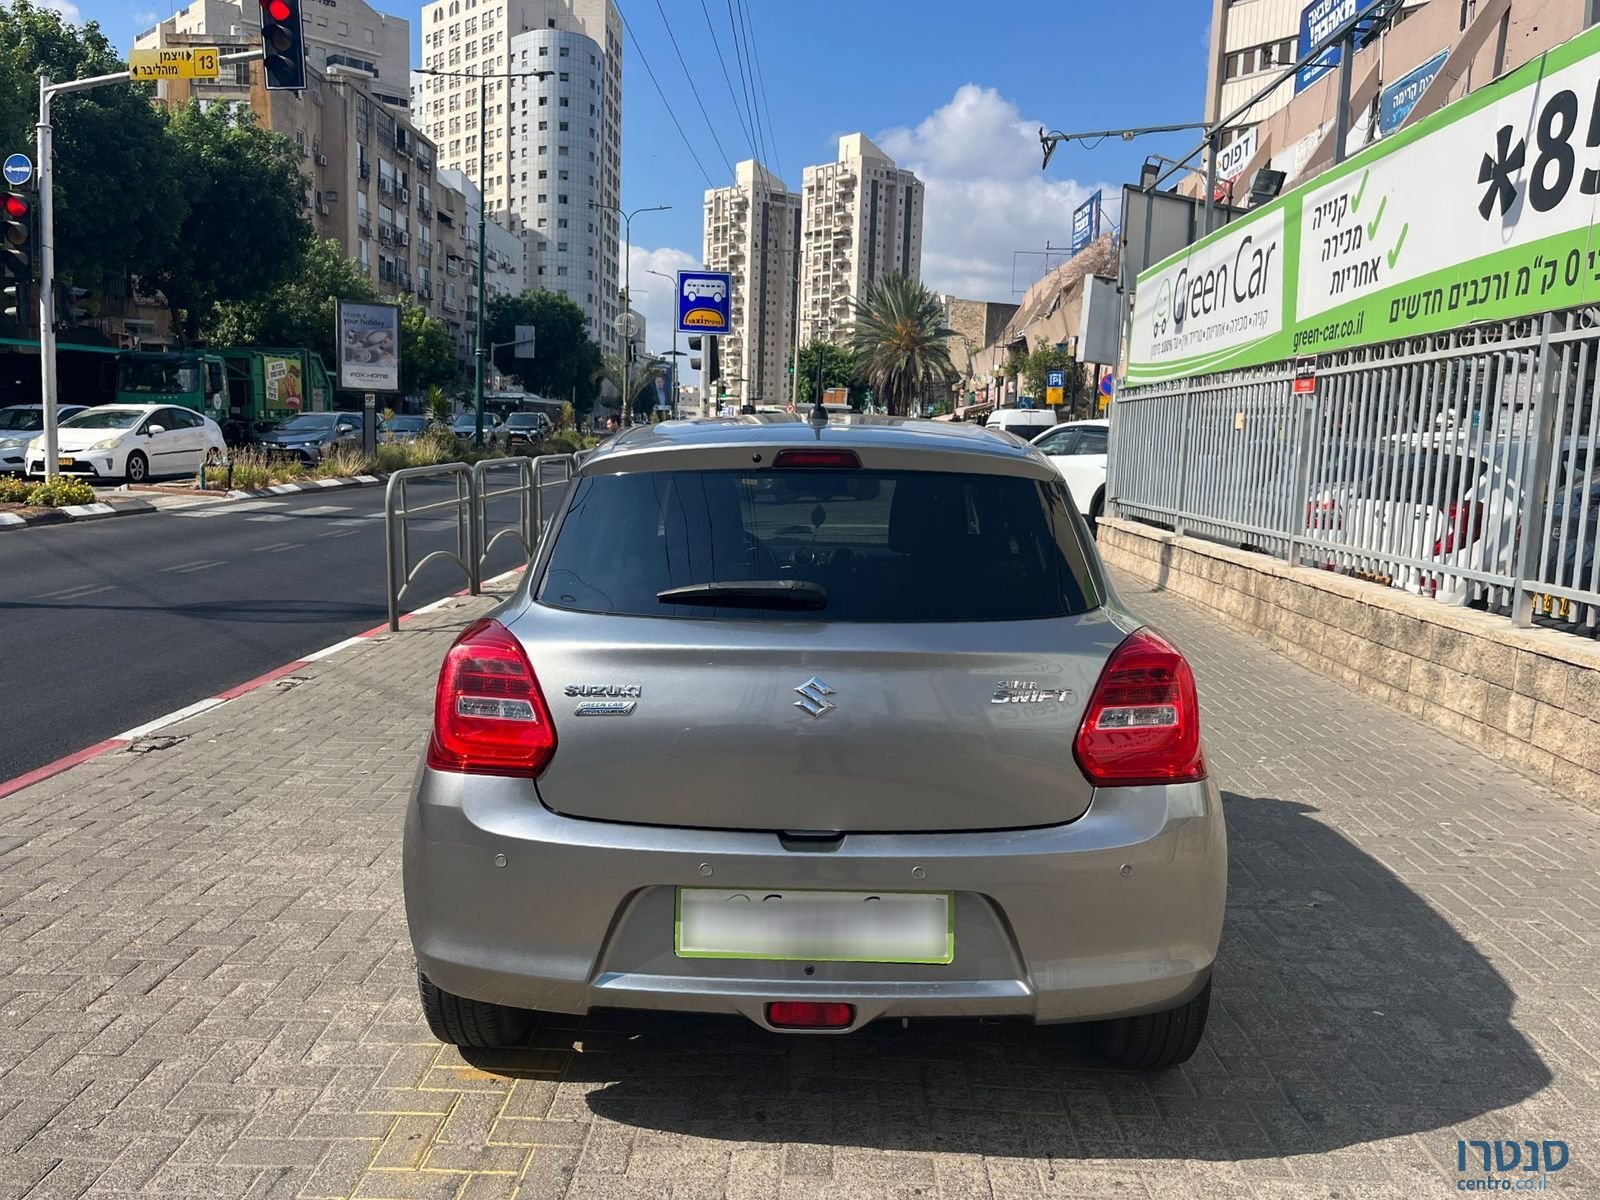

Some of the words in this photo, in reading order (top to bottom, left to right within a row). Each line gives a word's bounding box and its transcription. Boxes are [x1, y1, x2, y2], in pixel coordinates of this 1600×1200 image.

[160, 51, 184, 64] ויצמן
[199, 55, 214, 70] 13
[1393, 83, 1418, 108] קדימה
[1222, 137, 1250, 172] דפוס
[1312, 193, 1348, 231] קנייה
[1321, 224, 1363, 262] מכירה
[1173, 267, 1228, 324] Green
[1233, 235, 1276, 303] Car
[1329, 256, 1382, 296] אחריות
[1448, 271, 1510, 311] ורכבים
[1389, 288, 1443, 323] חדשים
[1292, 310, 1365, 353] green-car.co.il
[564, 685, 642, 698] SUZUKI
[990, 689, 1072, 704] SWIFT
[997, 680, 1038, 689] SUPER
